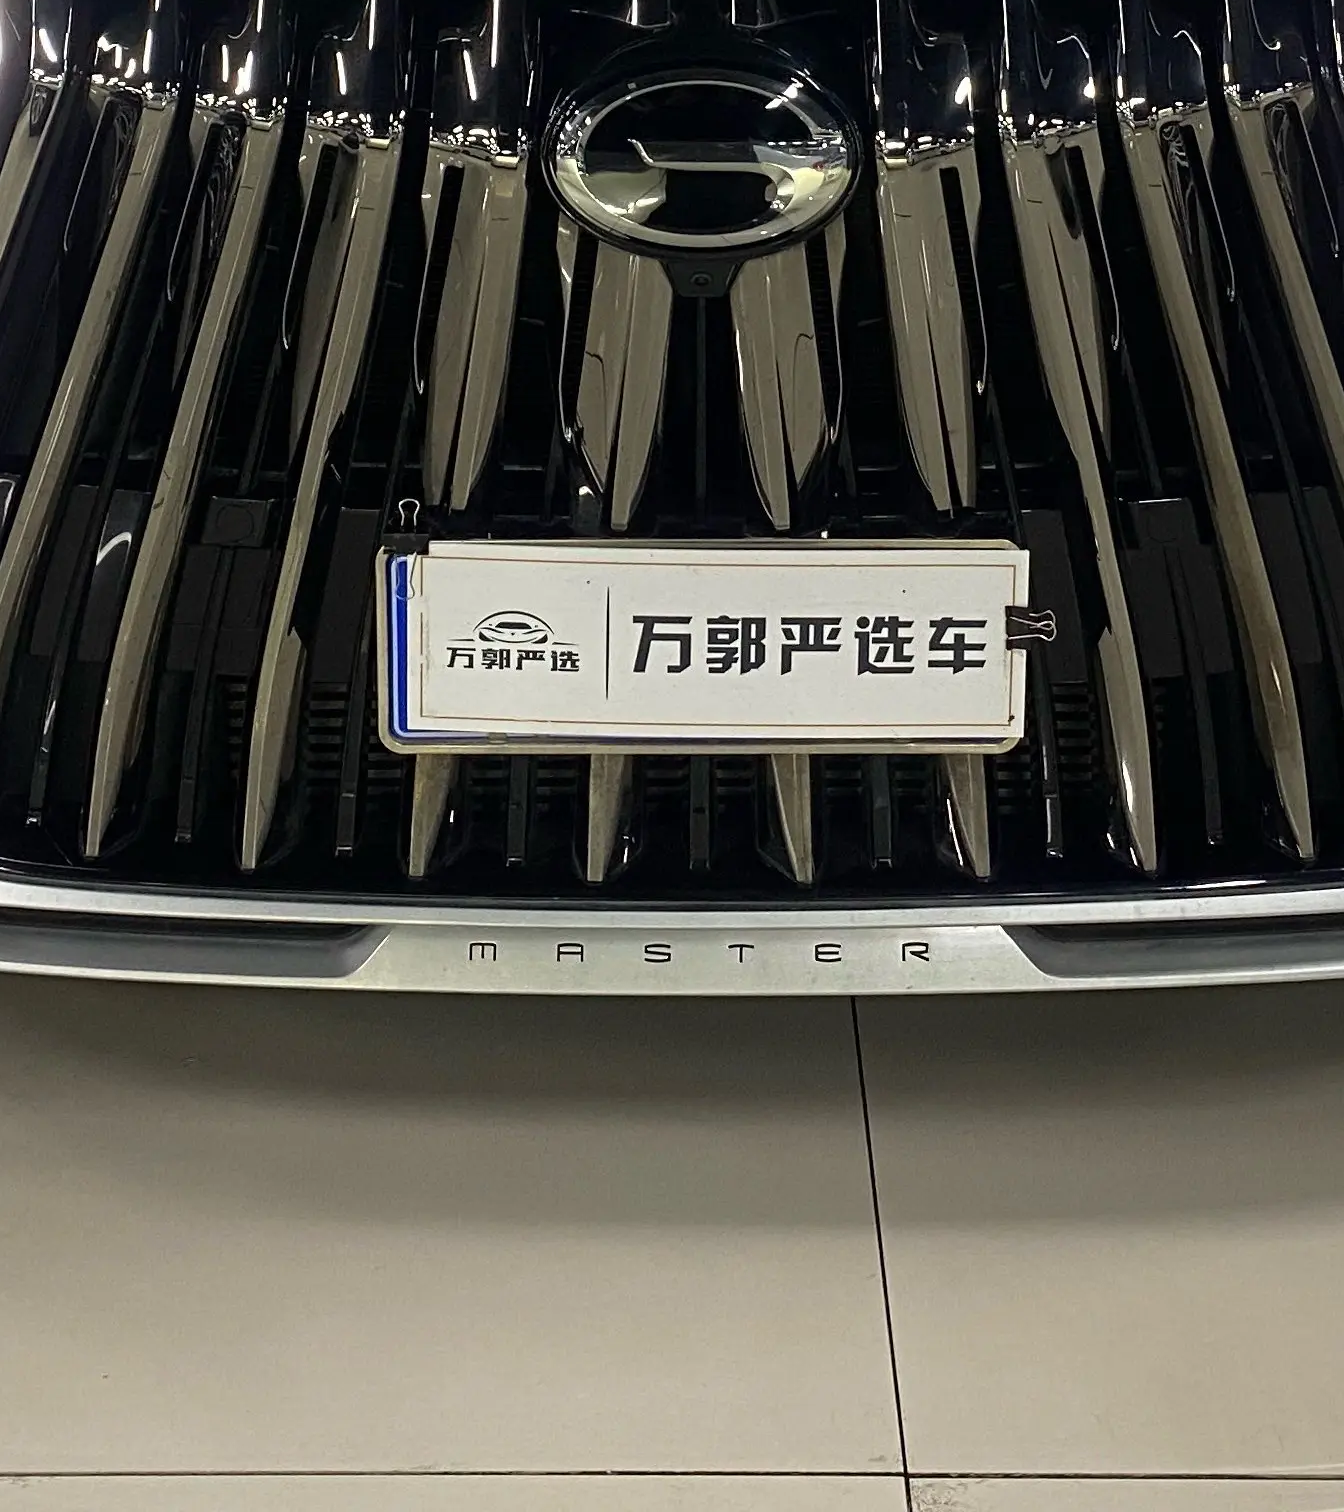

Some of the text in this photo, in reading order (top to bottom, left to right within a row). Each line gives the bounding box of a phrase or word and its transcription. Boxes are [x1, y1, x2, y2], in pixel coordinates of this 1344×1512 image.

[632, 615, 987, 675] 万郭严选车
[445, 646, 581, 673] 万郭严选
[469, 941, 930, 963] MASTER
